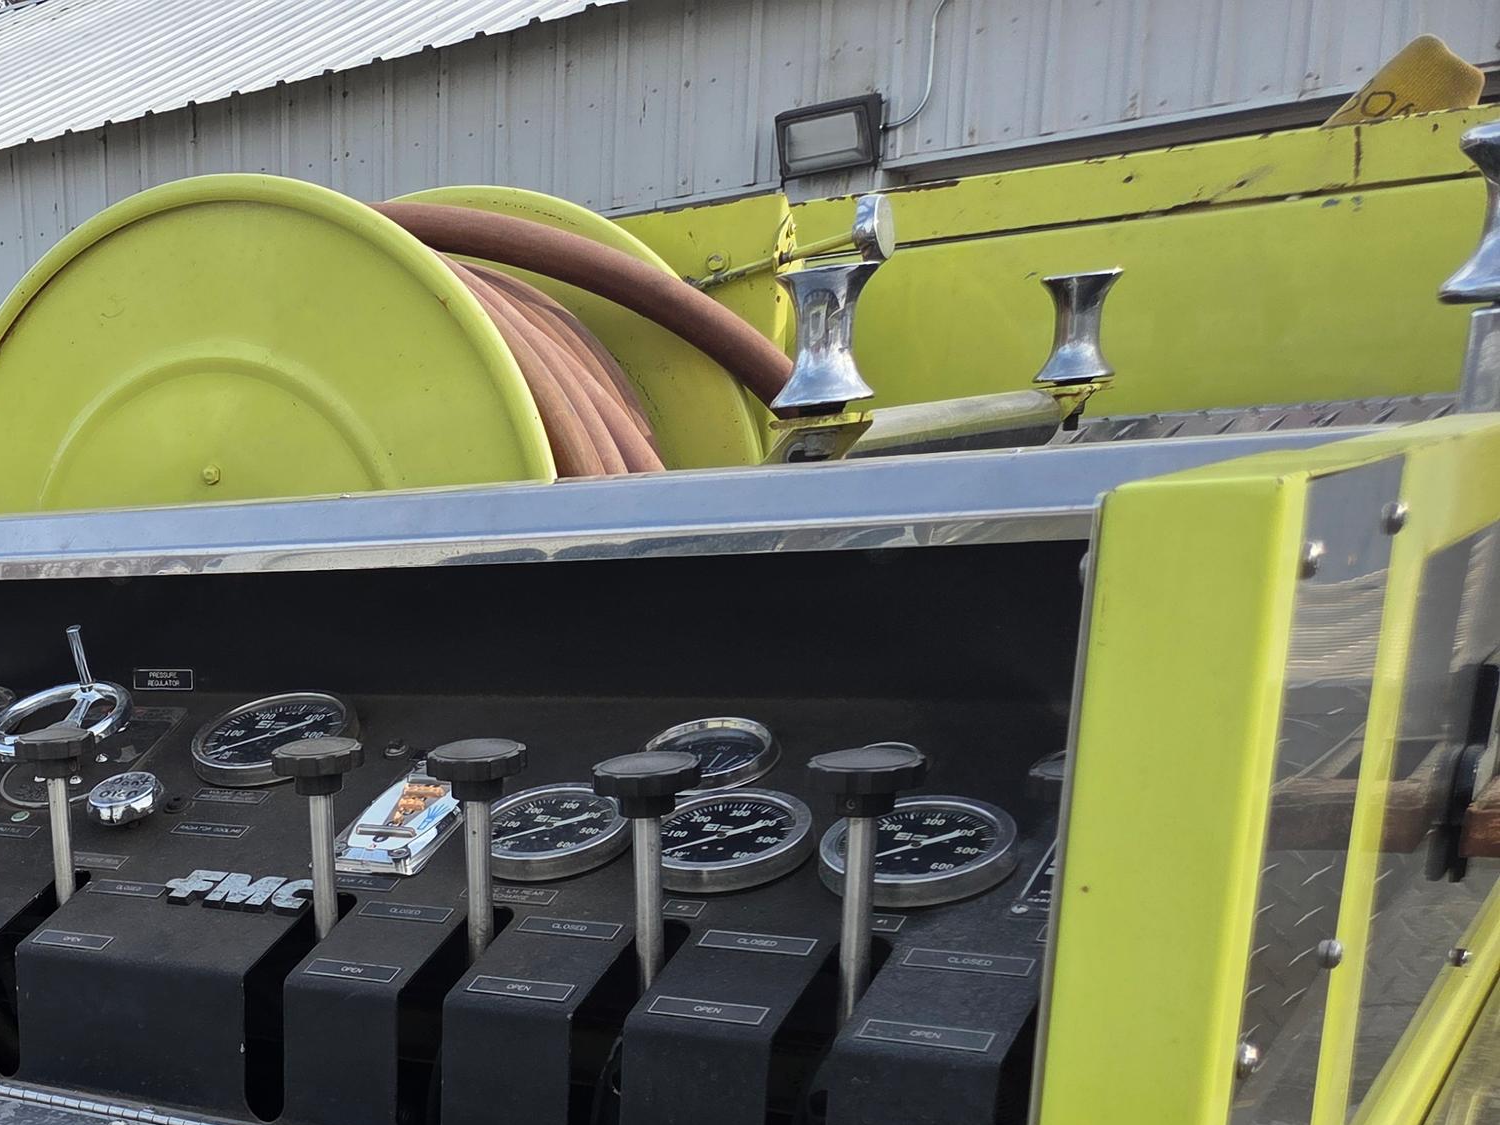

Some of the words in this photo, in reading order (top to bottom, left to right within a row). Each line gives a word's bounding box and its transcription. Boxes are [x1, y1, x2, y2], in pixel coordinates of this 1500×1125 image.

[148, 671, 178, 679] PRESSURE
[147, 679, 181, 687] REGULATOR
[255, 712, 276, 720] 200
[304, 713, 325, 722] 400
[224, 729, 245, 737] 100
[302, 731, 324, 739] 500
[560, 802, 580, 810] 300
[525, 807, 544, 815] 200
[730, 809, 751, 817] 300
[690, 815, 712, 823] 200
[922, 817, 946, 826] 300
[502, 820, 520, 828] 100
[879, 823, 902, 832] 200
[579, 827, 600, 835] 500
[668, 830, 689, 838] 100
[755, 836, 778, 844] 500
[556, 841, 576, 849] 600
[954, 846, 979, 855] 500
[929, 861, 955, 871] 600
[357, 878, 374, 886] FILL
[166, 869, 315, 915] FMC
[389, 906, 421, 916] CLOSED
[551, 922, 588, 931] CLOSED
[736, 937, 778, 948] CLOSED
[947, 956, 993, 967] CLOSED
[340, 965, 364, 975] OPEN
[506, 982, 532, 992] OPEN
[693, 1005, 723, 1016] OPEN
[909, 1030, 942, 1041] OPEN
